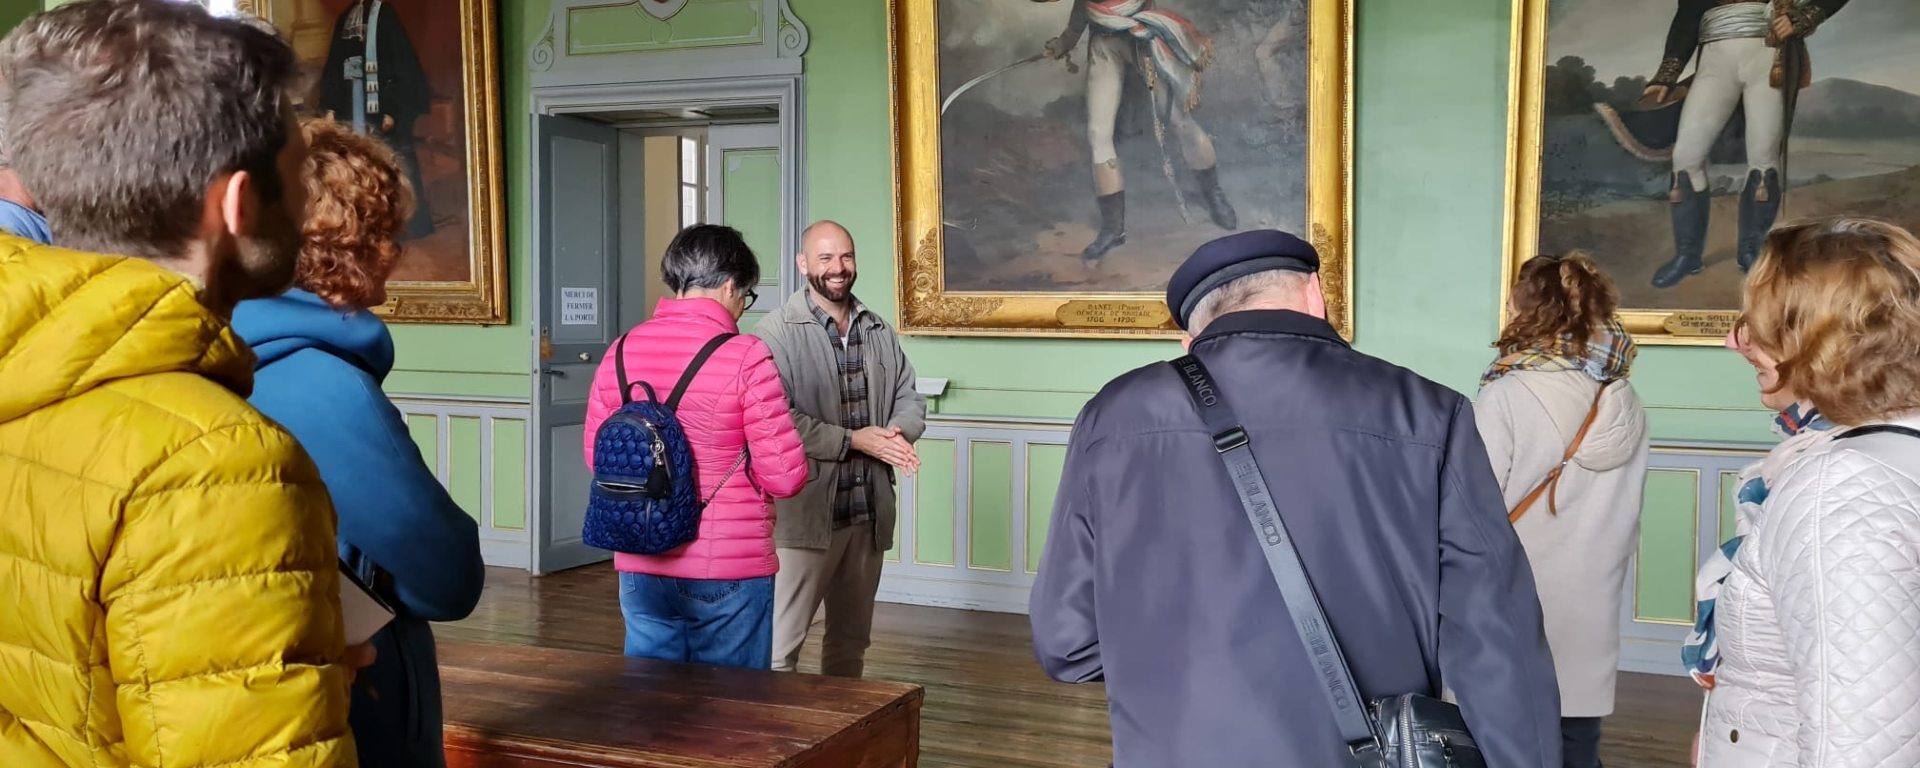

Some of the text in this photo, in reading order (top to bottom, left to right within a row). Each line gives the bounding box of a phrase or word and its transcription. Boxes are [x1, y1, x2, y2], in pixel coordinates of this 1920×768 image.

[564, 313, 594, 321] LA PORTE
[566, 302, 593, 310] FERMER
[1183, 363, 1217, 407] BLANCO
[1245, 481, 1281, 546] BLANCO
